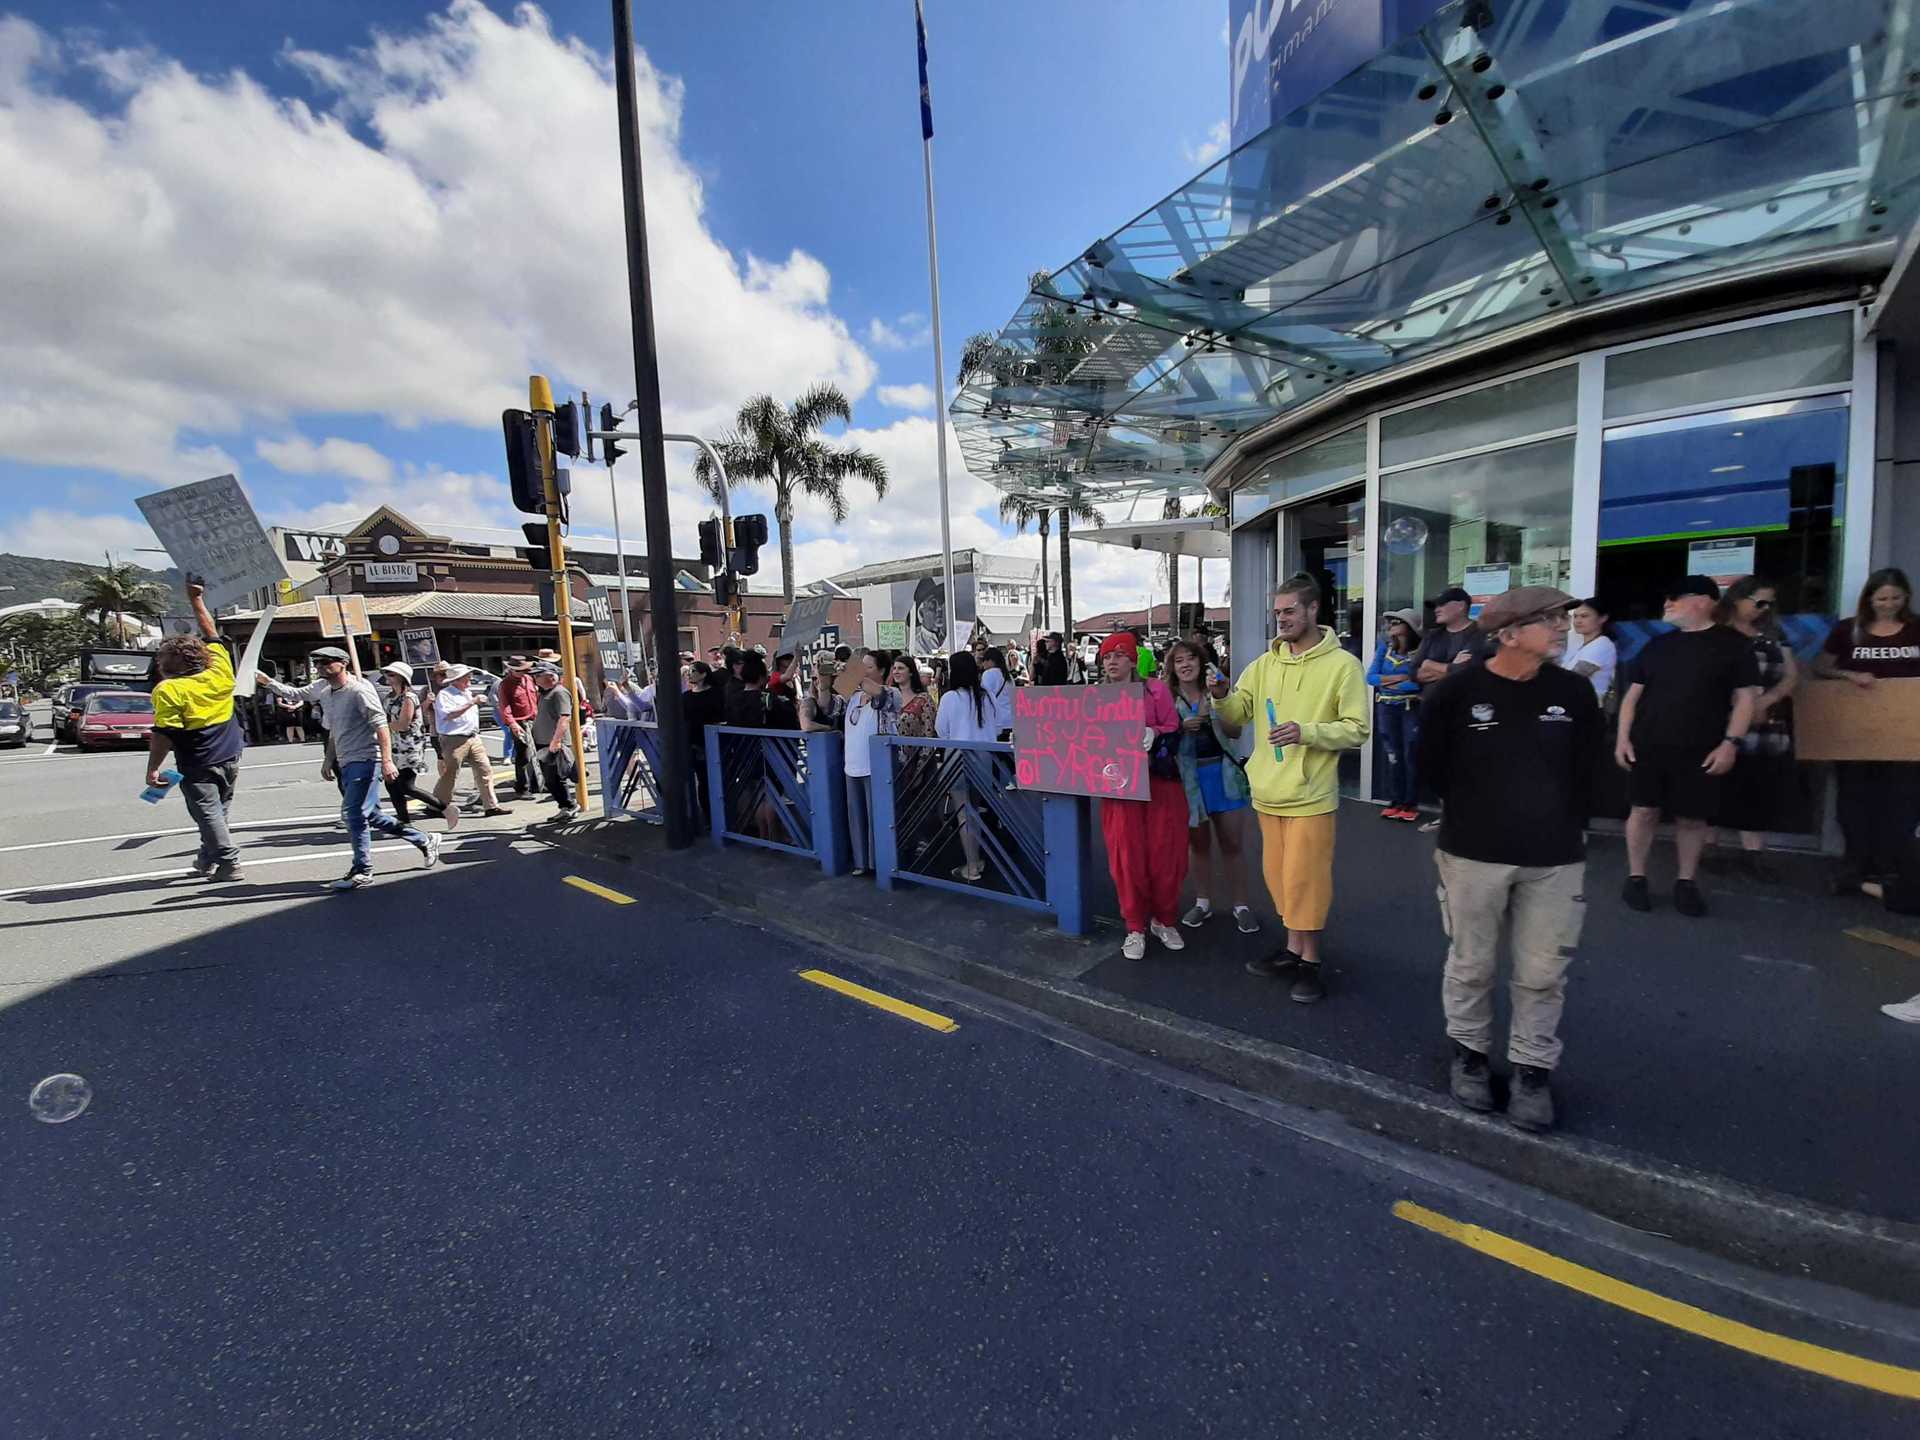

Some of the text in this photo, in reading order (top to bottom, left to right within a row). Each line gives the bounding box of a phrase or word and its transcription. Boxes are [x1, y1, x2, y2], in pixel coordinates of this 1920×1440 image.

[368, 563, 414, 577] LE BISTRO
[587, 596, 611, 621] THE
[405, 630, 431, 641] TIME
